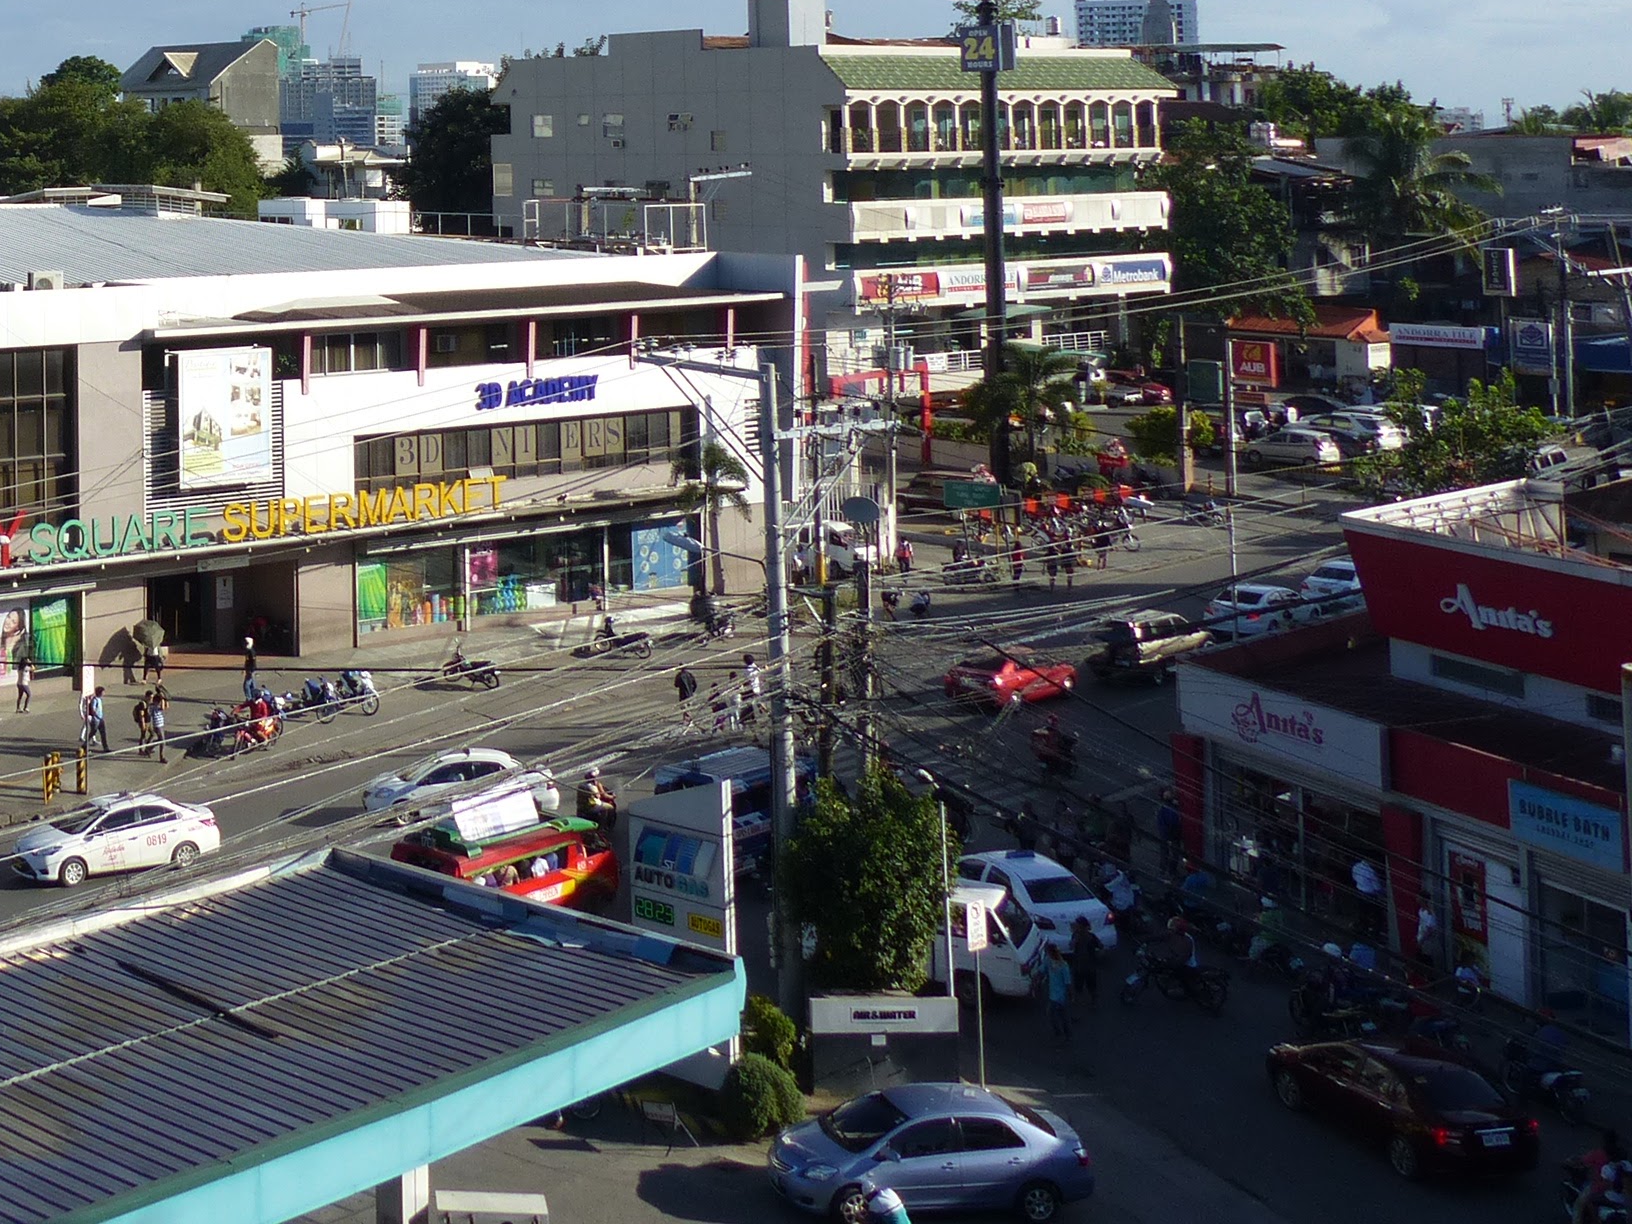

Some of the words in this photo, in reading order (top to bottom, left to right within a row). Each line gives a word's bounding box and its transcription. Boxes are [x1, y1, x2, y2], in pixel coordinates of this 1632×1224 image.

[963, 36, 996, 60] 24
[1113, 267, 1160, 284] Metrobank
[1397, 328, 1449, 339] ANDORRA
[1240, 361, 1265, 373] AUB
[474, 381, 503, 411] 3D
[505, 374, 599, 408] ACADEMY
[399, 434, 440, 466] 3D
[28, 507, 211, 564] SQUARE
[223, 475, 508, 542] SUPERMARKET
[1440, 583, 1553, 638] Anita's
[1234, 690, 1324, 745] Anita's
[1518, 798, 1568, 828] BUBBLE
[1573, 816, 1610, 842] BATH
[634, 865, 675, 890] AUTO
[676, 876, 710, 899] GAS
